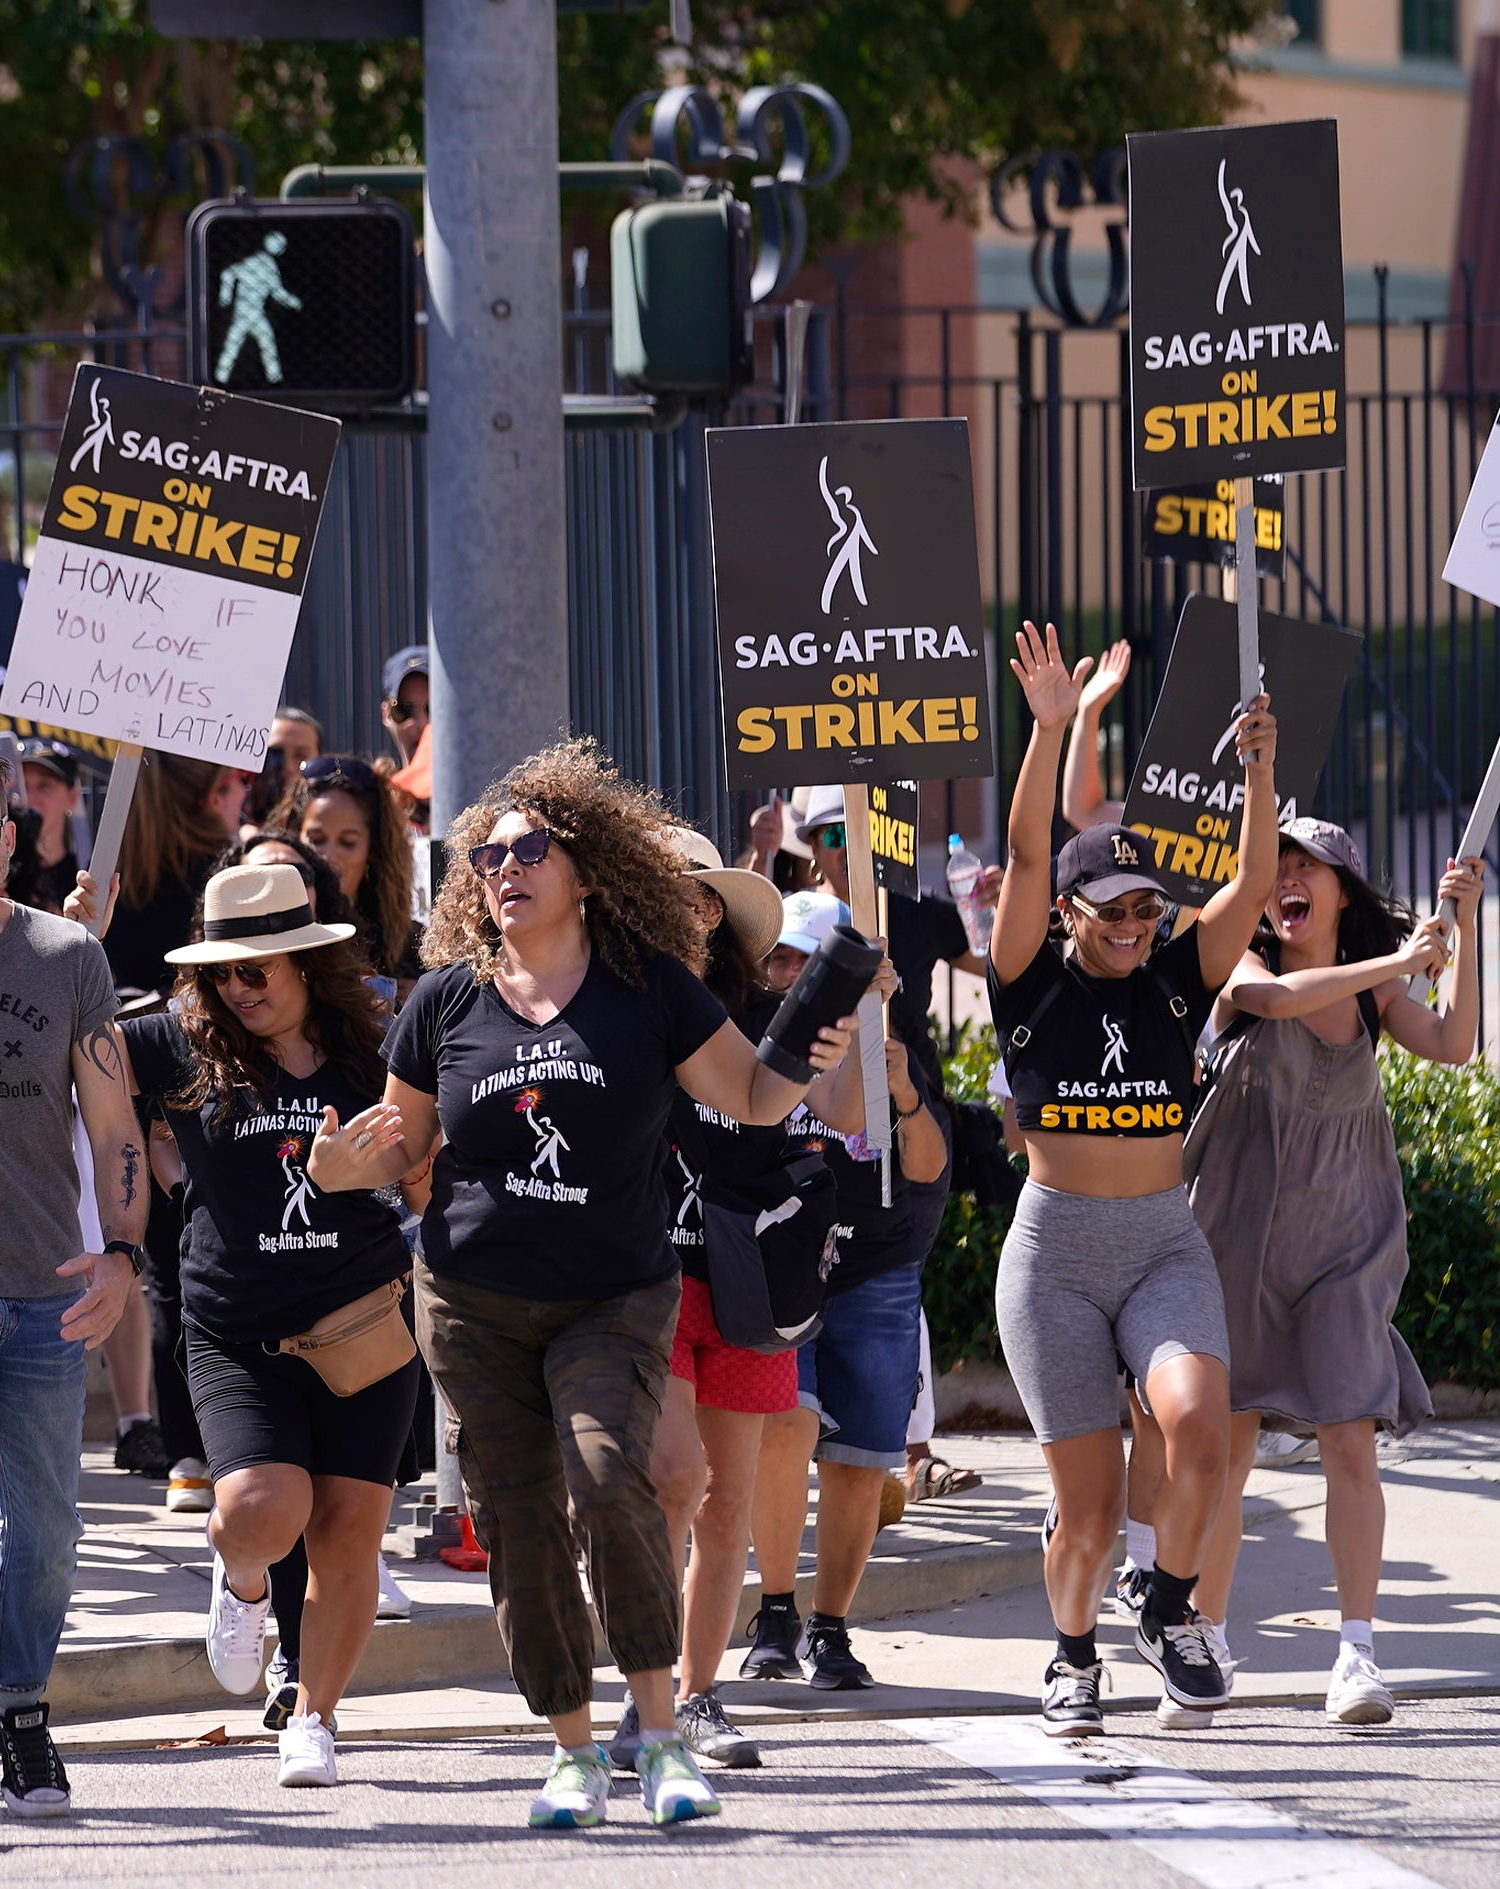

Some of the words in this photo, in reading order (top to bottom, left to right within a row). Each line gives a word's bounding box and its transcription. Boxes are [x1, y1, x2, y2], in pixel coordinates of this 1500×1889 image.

[1221, 369, 1258, 396] ON
[1144, 389, 1337, 452] STRIKE!
[163, 478, 212, 508] ON
[57, 484, 300, 579] STRIKE!
[1154, 495, 1283, 552] STRIE!
[58, 553, 164, 613] HONK
[217, 598, 257, 628] IF
[56, 608, 107, 644] YOU
[132, 630, 211, 661] LOVE
[20, 680, 100, 716] AND
[90, 659, 216, 709] MOVIES
[831, 673, 880, 697] ON
[737, 697, 979, 753] STRIKE!
[872, 786, 887, 812] ON
[868, 808, 915, 867] RIKE!
[1196, 814, 1231, 841] ON
[1111, 834, 1139, 866] LA
[516, 1039, 568, 1062] L.A.U.
[471, 1065, 526, 1105] LATINAS
[527, 1060, 579, 1082] ACTING
[579, 1061, 606, 1088] UP!
[234, 1114, 286, 1141] LATINAS
[1040, 1103, 1183, 1130] STRONG
[505, 1171, 551, 1200] Sag-Aftra
[552, 1181, 589, 1205] Strong
[259, 1232, 304, 1253] Sag-Aftra
[305, 1230, 339, 1249] Strong
